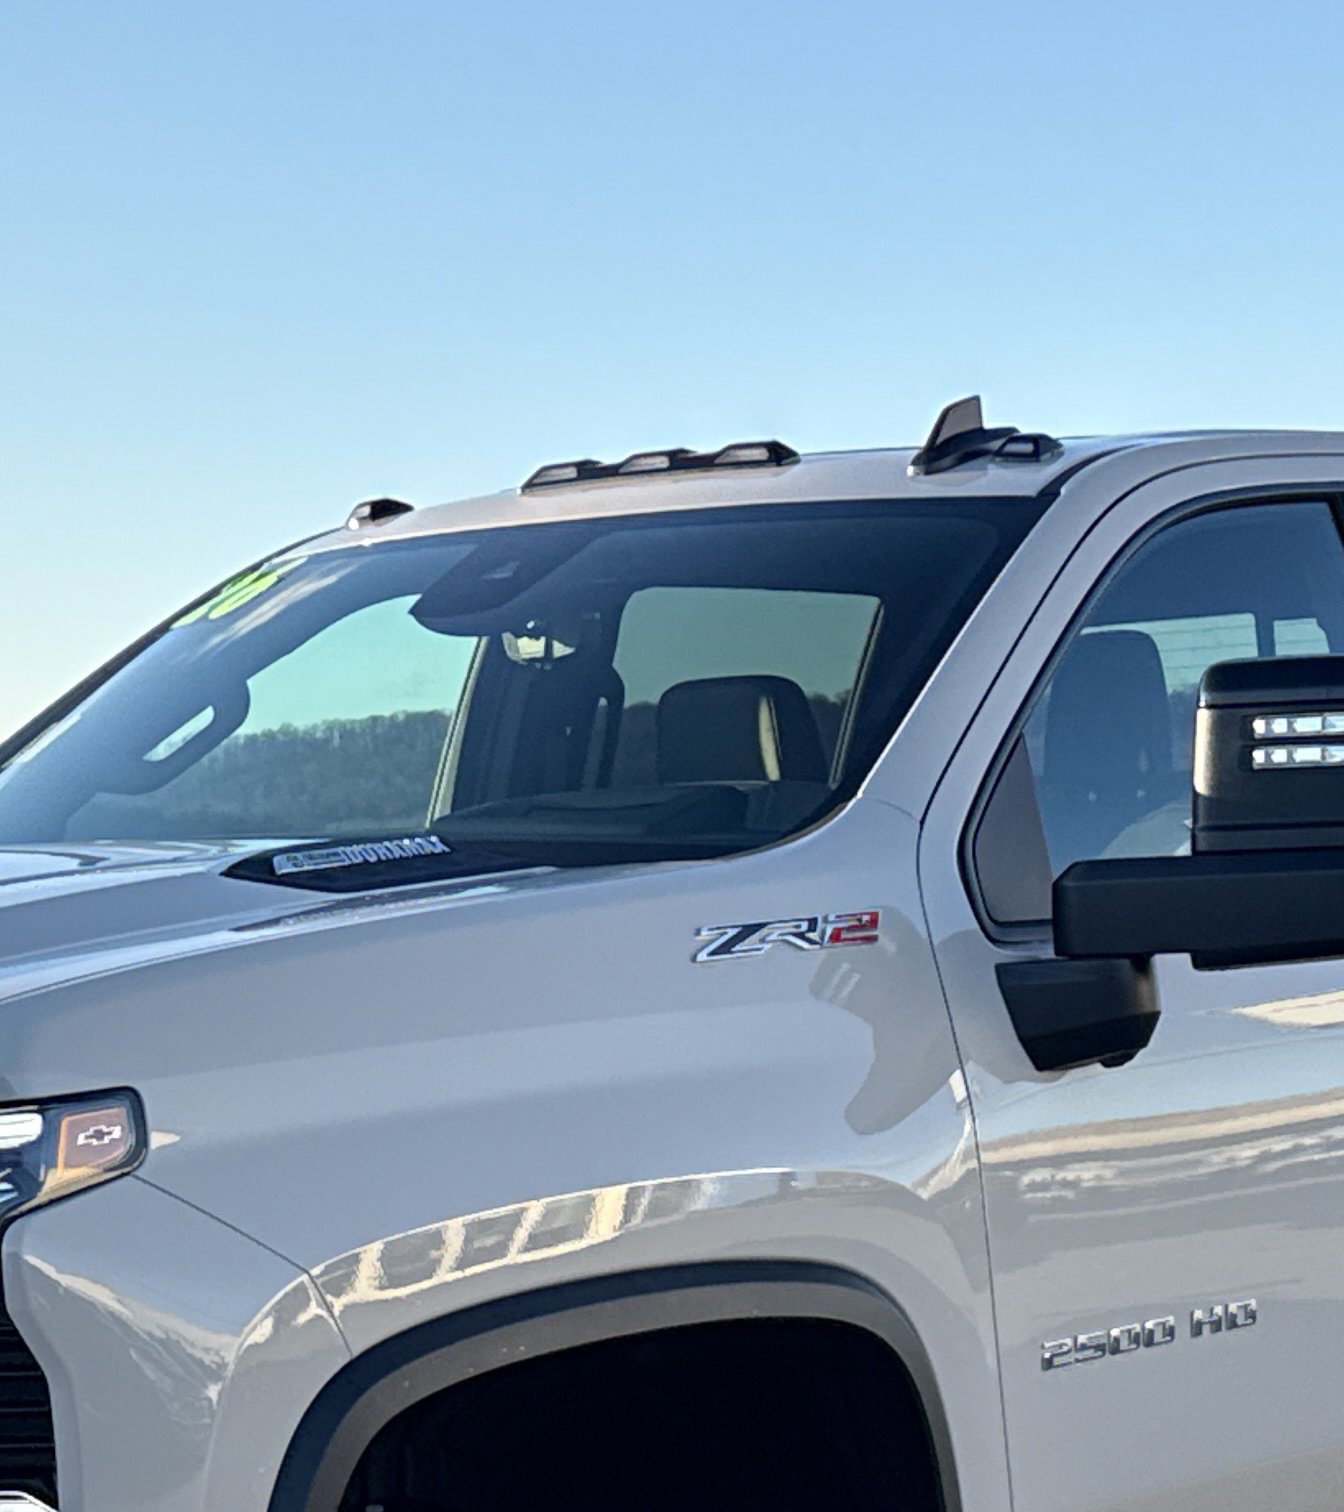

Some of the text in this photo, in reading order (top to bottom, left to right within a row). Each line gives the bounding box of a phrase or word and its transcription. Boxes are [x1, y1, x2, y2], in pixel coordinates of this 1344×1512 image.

[691, 909, 882, 964] ZR2
[1040, 1299, 1258, 1372] 2500 HD
